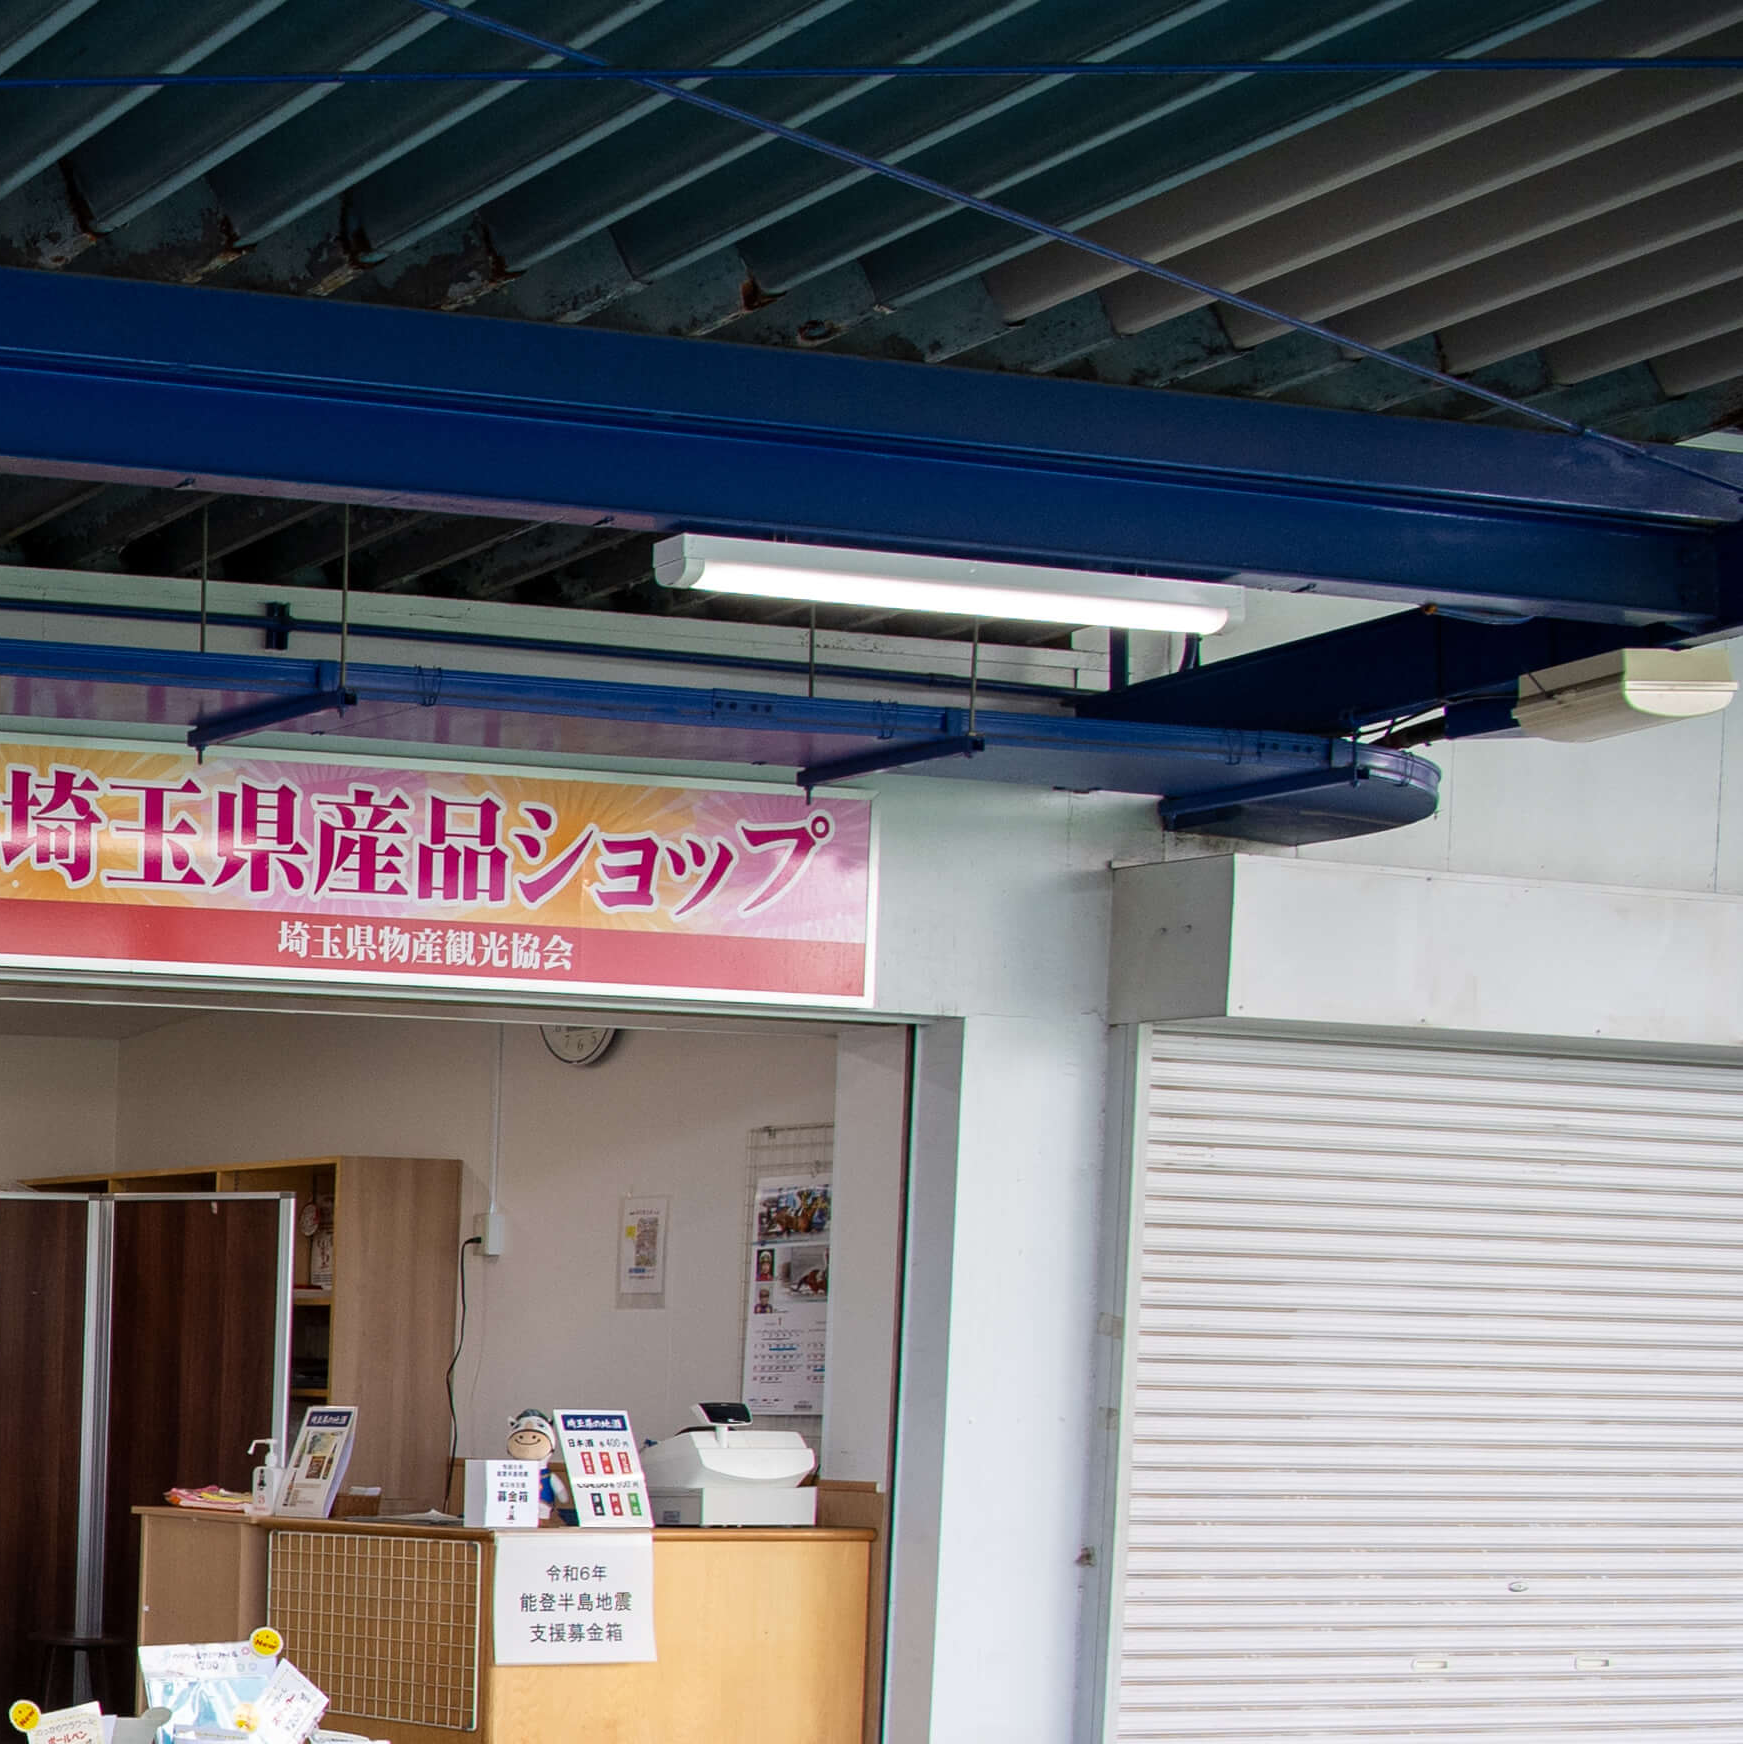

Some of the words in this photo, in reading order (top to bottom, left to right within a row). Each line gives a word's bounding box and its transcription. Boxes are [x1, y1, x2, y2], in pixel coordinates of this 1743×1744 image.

[276, 919, 575, 973] 埼玉県物産観光協会
[566, 1419, 622, 1430] 埼玉県の地酒
[567, 1438, 594, 1448] 日本酒
[497, 1490, 529, 1503] 募金箱
[546, 1564, 607, 1583] 令和6年
[520, 1592, 633, 1613] 能登半島地震
[530, 1622, 623, 1642] 支援募金箱
[254, 1637, 278, 1650] New
[19, 1709, 35, 1727] New
